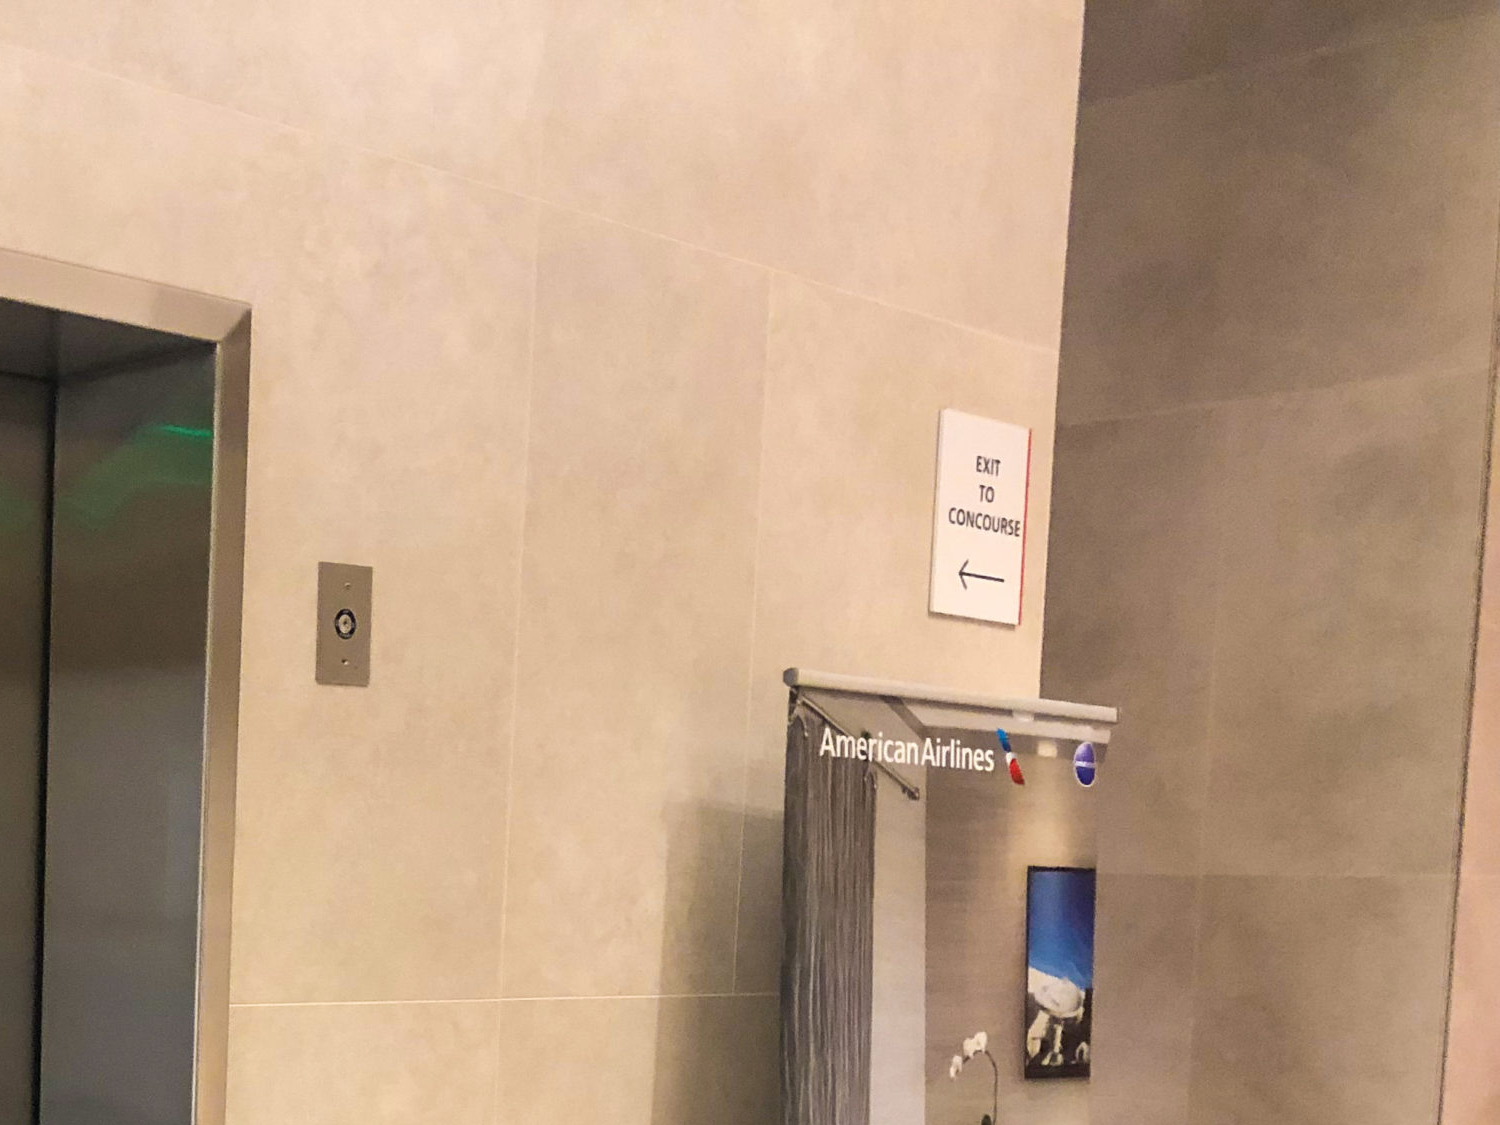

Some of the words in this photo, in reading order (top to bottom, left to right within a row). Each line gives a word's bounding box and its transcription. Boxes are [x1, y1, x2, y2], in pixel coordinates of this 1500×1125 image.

[976, 455, 1001, 476] EXIT
[979, 484, 995, 503] TO
[948, 507, 1021, 537] CONCOURSE
